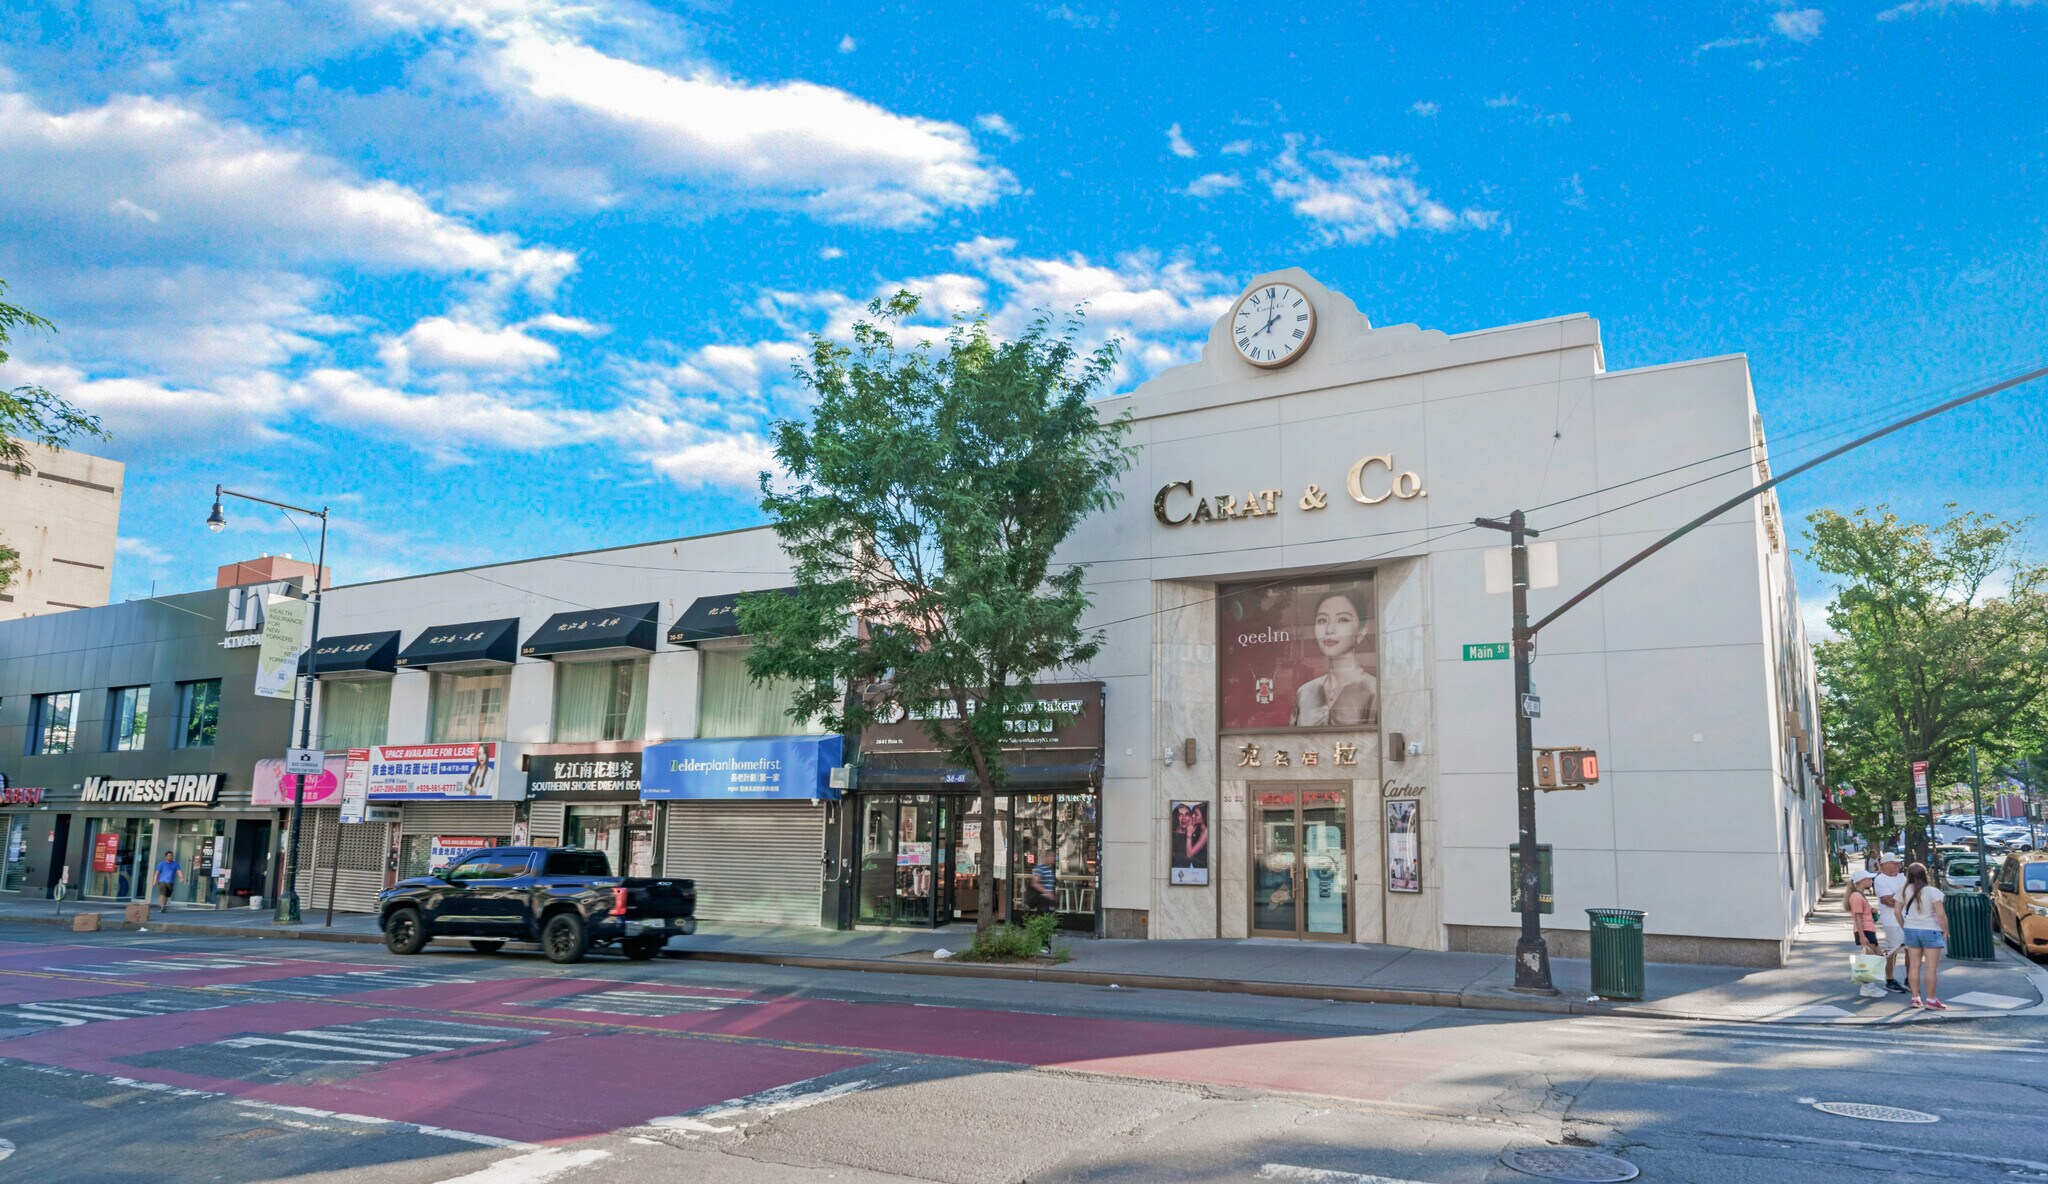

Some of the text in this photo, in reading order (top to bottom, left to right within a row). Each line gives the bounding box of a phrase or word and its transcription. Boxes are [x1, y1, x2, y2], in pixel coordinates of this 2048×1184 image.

[1153, 479, 1282, 526] CARAT
[1299, 483, 1328, 511] &
[269, 608, 293, 616] HEALTH
[269, 614, 303, 625] INSURANCE
[266, 634, 294, 643] YORKERS
[1469, 645, 1505, 659] Main St
[269, 656, 297, 666] YORKERS
[385, 746, 475, 759] SPACE AVAILABLE FOR LEASE
[554, 760, 634, 779] 忆江南花想容
[531, 781, 571, 791] SOUTHERN
[571, 780, 597, 791] SHORE
[597, 780, 625, 791] DREAM
[1382, 779, 1426, 798] Cartier
